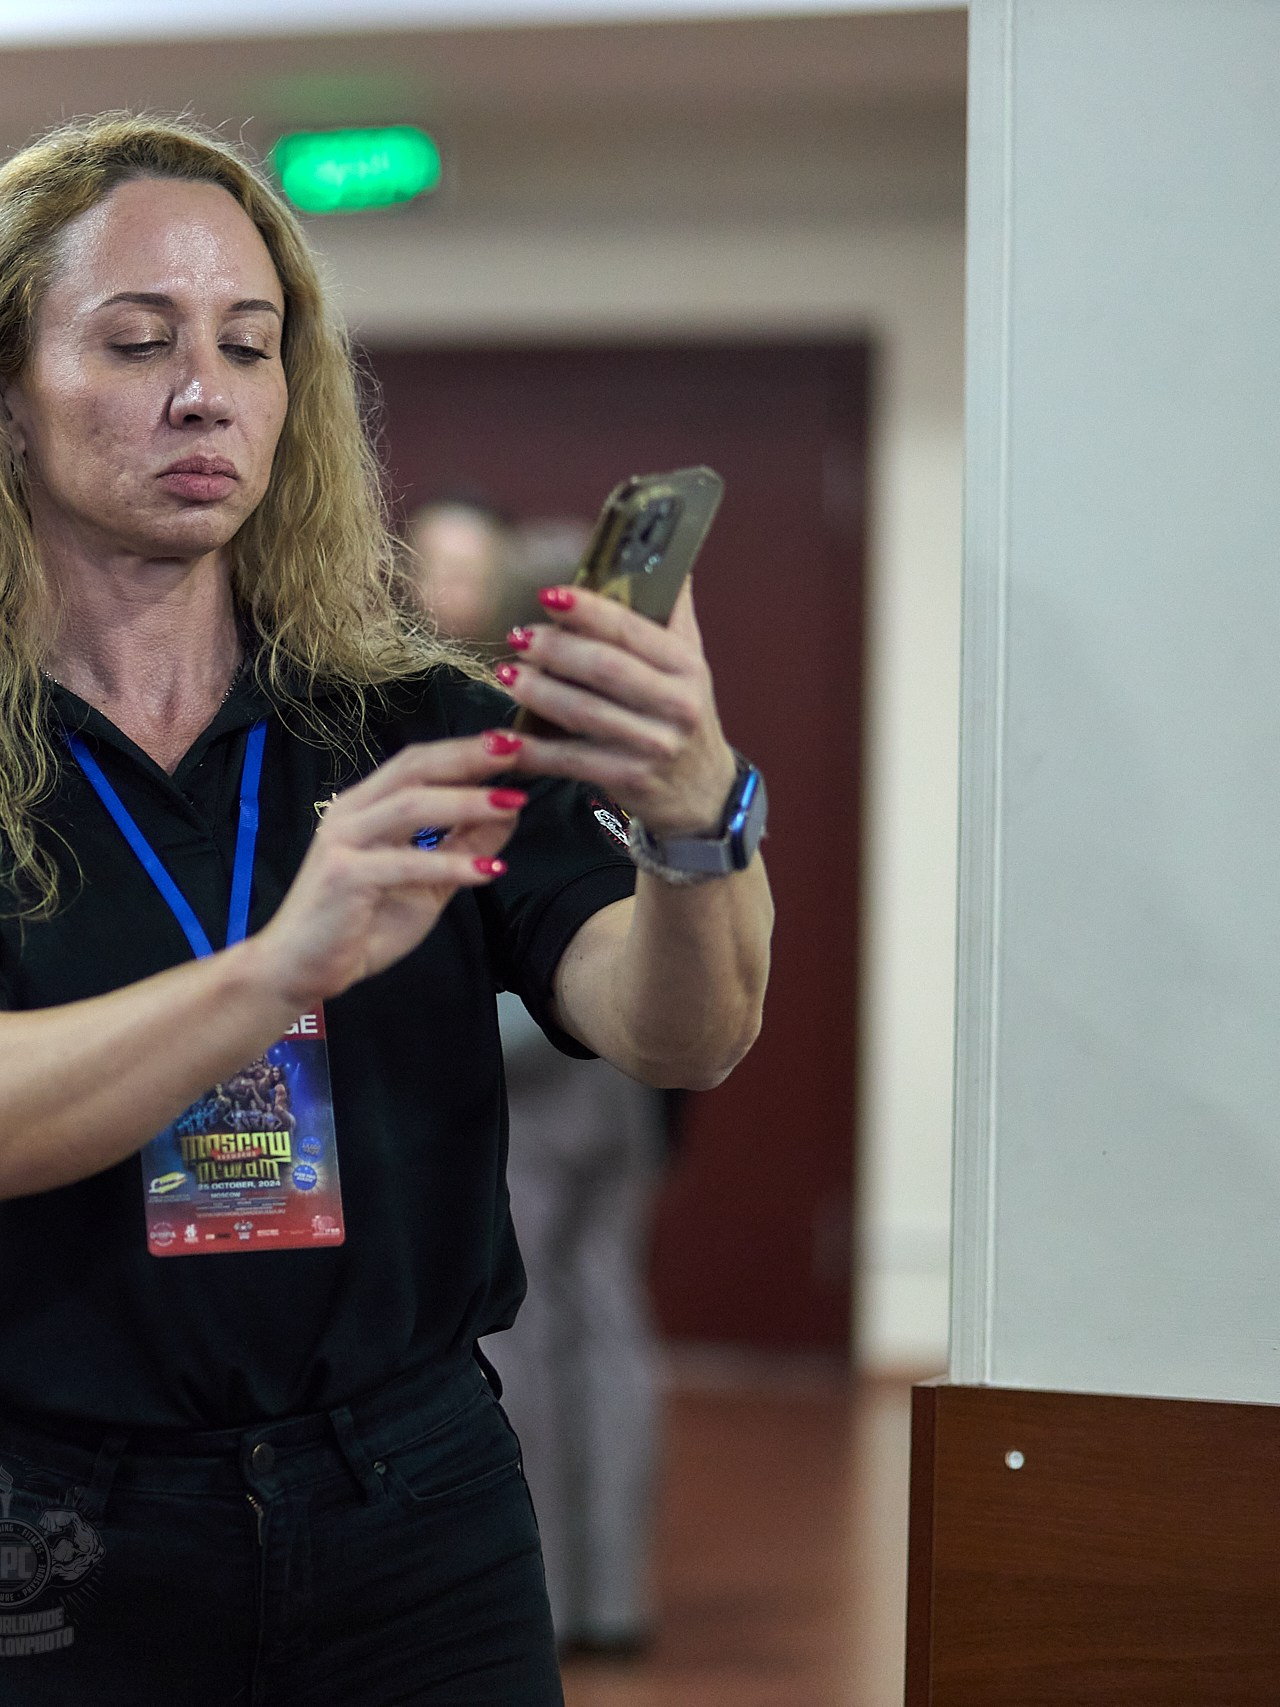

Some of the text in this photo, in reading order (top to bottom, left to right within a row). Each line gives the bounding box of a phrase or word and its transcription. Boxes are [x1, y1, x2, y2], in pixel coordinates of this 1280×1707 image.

[198, 1180, 281, 1191] 25 OCTOBER, 2024
